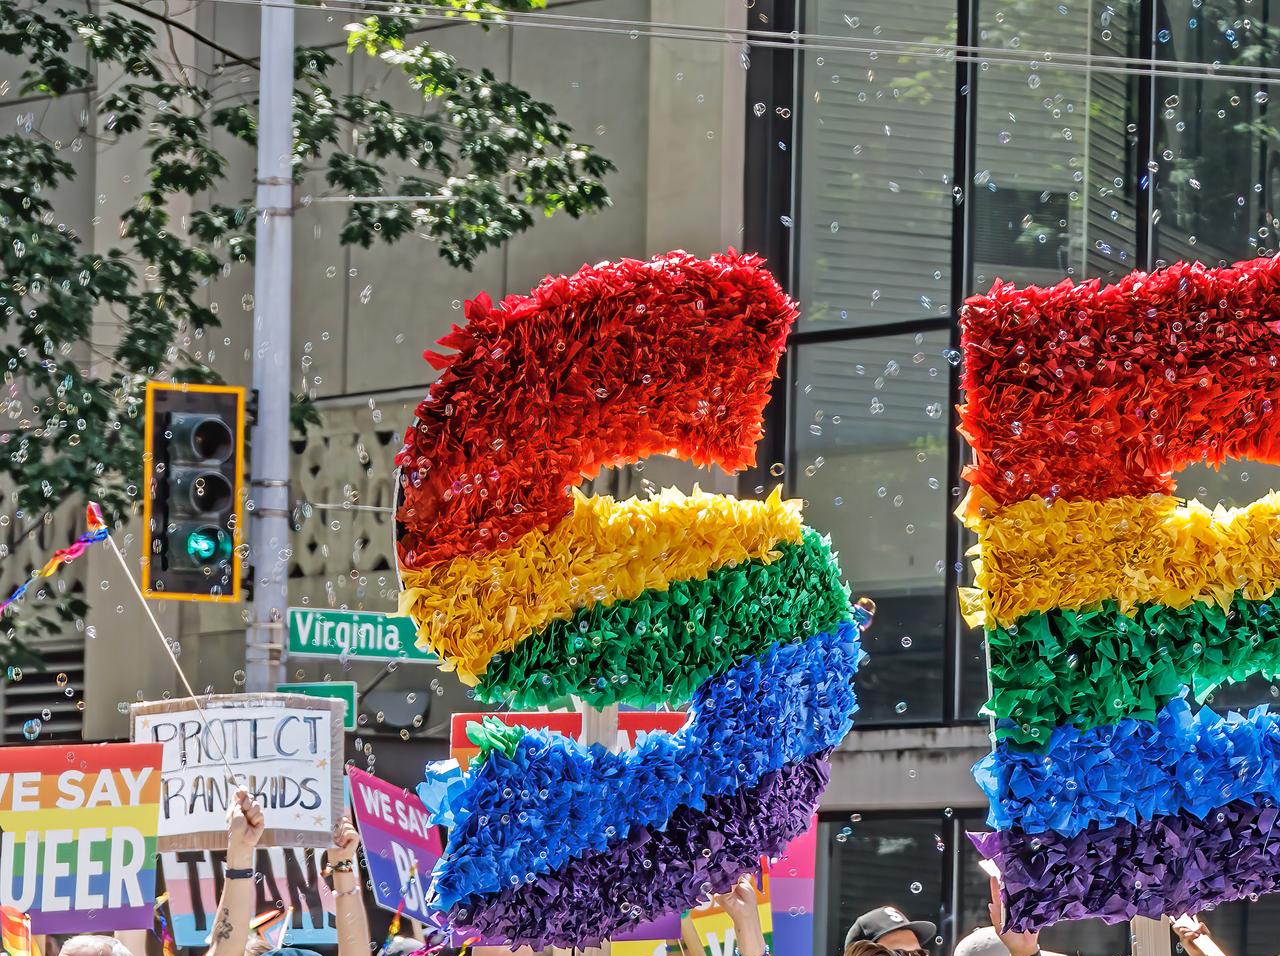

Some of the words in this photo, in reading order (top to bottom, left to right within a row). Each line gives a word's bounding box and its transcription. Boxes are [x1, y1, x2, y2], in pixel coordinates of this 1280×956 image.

[294, 611, 400, 651] Virginia
[152, 716, 323, 765] PROTECT
[56, 766, 155, 811] SAY
[250, 775, 323, 810] KIDS
[358, 782, 395, 825] WE
[394, 799, 430, 841] SAY
[0, 826, 145, 913] UEER
[391, 840, 430, 918] BI
